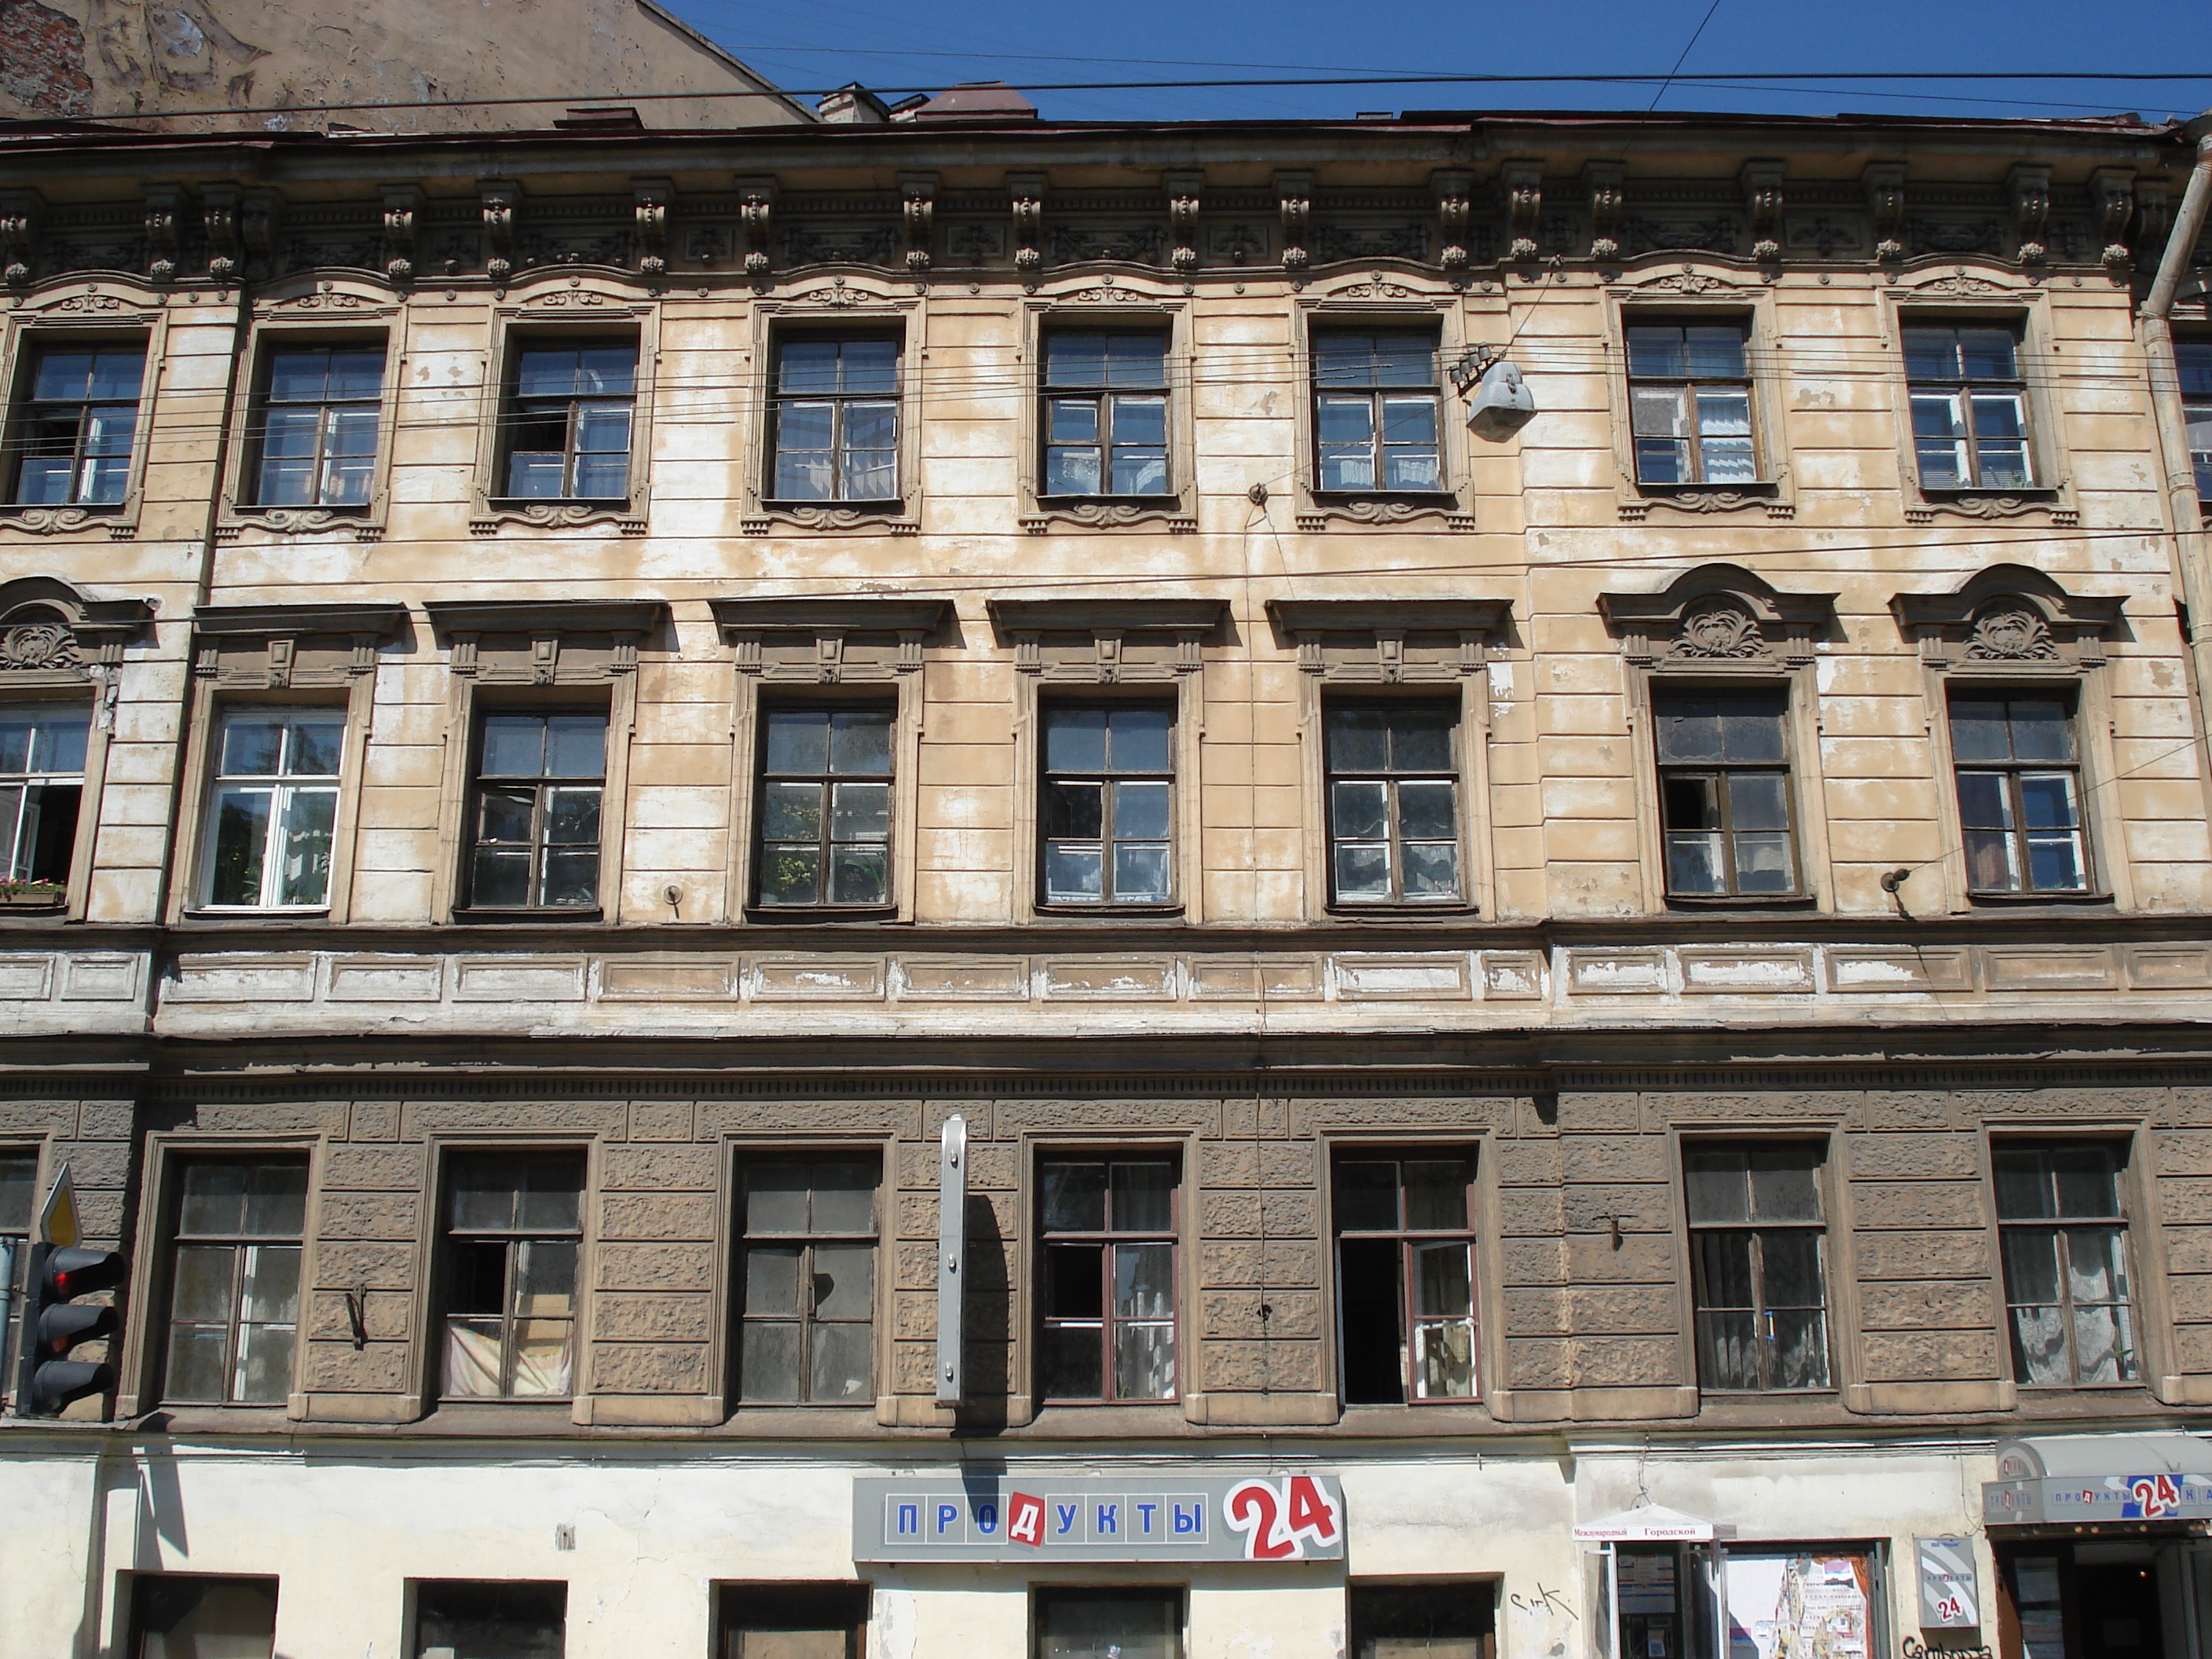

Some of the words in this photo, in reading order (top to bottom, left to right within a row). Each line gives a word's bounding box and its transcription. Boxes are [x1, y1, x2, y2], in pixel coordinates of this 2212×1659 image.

[2055, 1490, 2131, 1503] ПРОДУКТЫ
[2133, 1475, 2179, 1517] 24
[897, 1502, 1203, 1542] ПРОДУКТЫ
[1225, 1476, 1339, 1558] 24
[1573, 1527, 1628, 1538] Международный
[1644, 1527, 1696, 1536] Городской
[1937, 1595, 1962, 1621] 24
